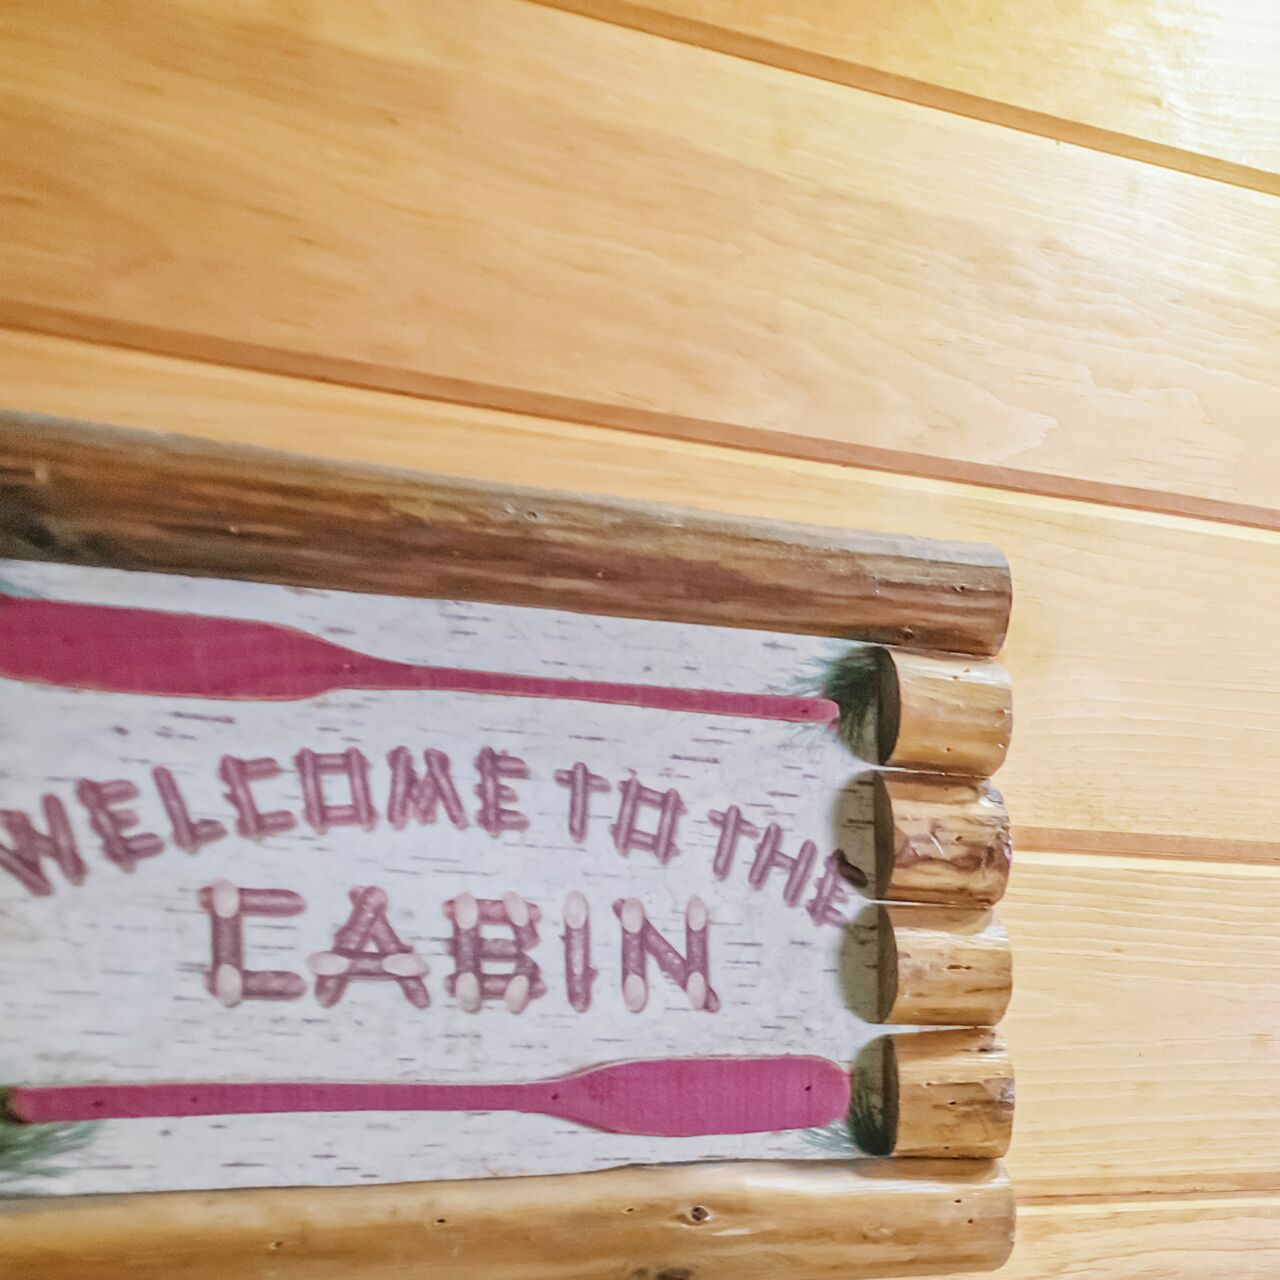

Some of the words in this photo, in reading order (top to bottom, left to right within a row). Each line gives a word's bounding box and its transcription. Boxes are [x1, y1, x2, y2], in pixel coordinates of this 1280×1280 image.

[0, 745, 531, 897] WELCOME
[555, 761, 687, 864] TO
[707, 804, 867, 927] THE
[198, 878, 721, 1014] CABIN
